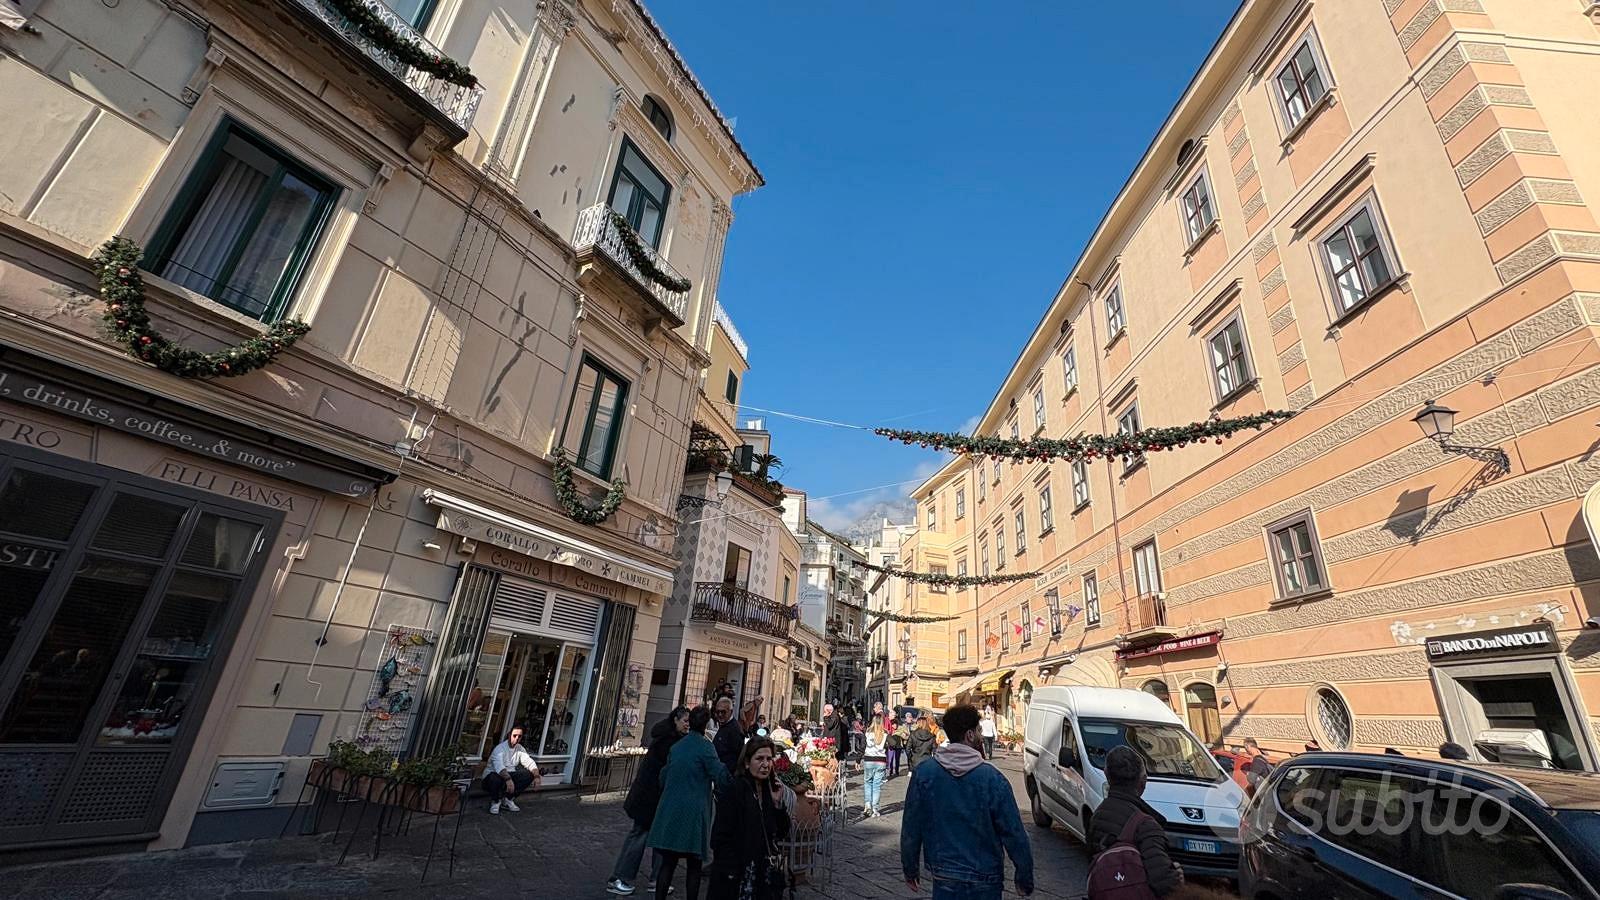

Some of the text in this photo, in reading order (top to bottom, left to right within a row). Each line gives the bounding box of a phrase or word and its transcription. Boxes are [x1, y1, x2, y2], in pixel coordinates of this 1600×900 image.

[23, 383, 116, 425] drinks,
[228, 480, 295, 512] PANSA
[486, 526, 539, 552] CORALLO
[620, 570, 650, 587] CAMMEI
[490, 550, 540, 577] Corallo
[1442, 637, 1485, 653] BANCO
[1495, 630, 1551, 648] NAPOLI
